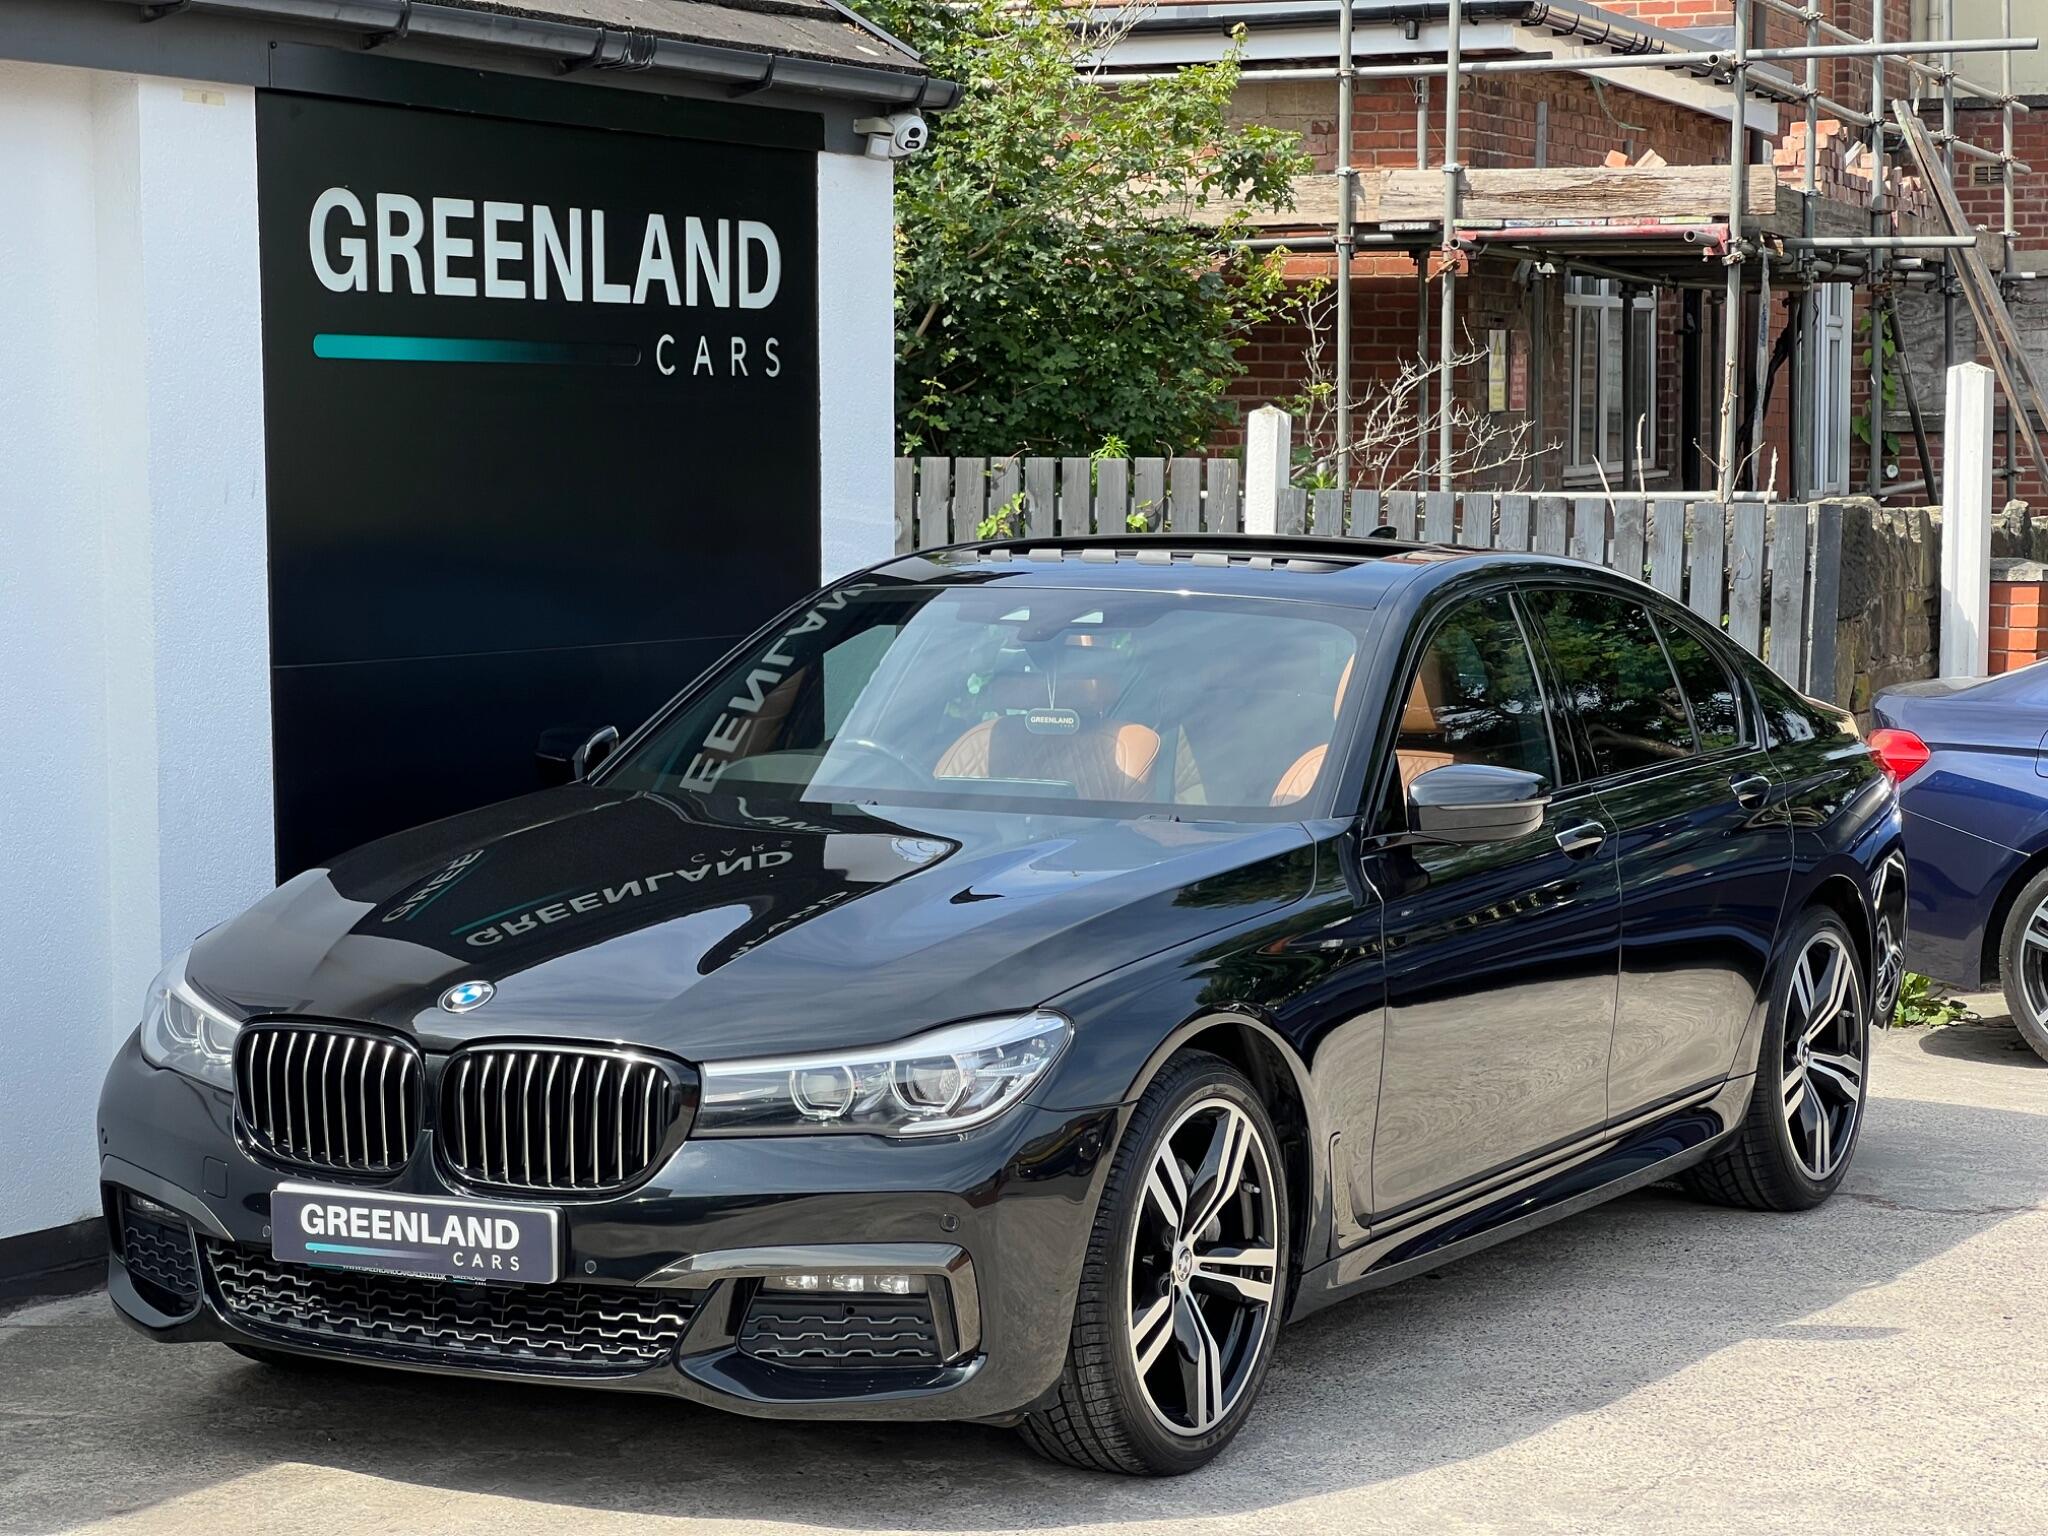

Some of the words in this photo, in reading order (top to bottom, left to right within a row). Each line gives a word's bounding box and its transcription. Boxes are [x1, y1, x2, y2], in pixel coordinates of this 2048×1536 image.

[309, 187, 781, 309] GREENLAND
[655, 333, 781, 378] CARS
[1030, 716, 1075, 725] GREENLAND
[300, 1203, 520, 1250] GREENLAND
[452, 1251, 521, 1272] CARS
